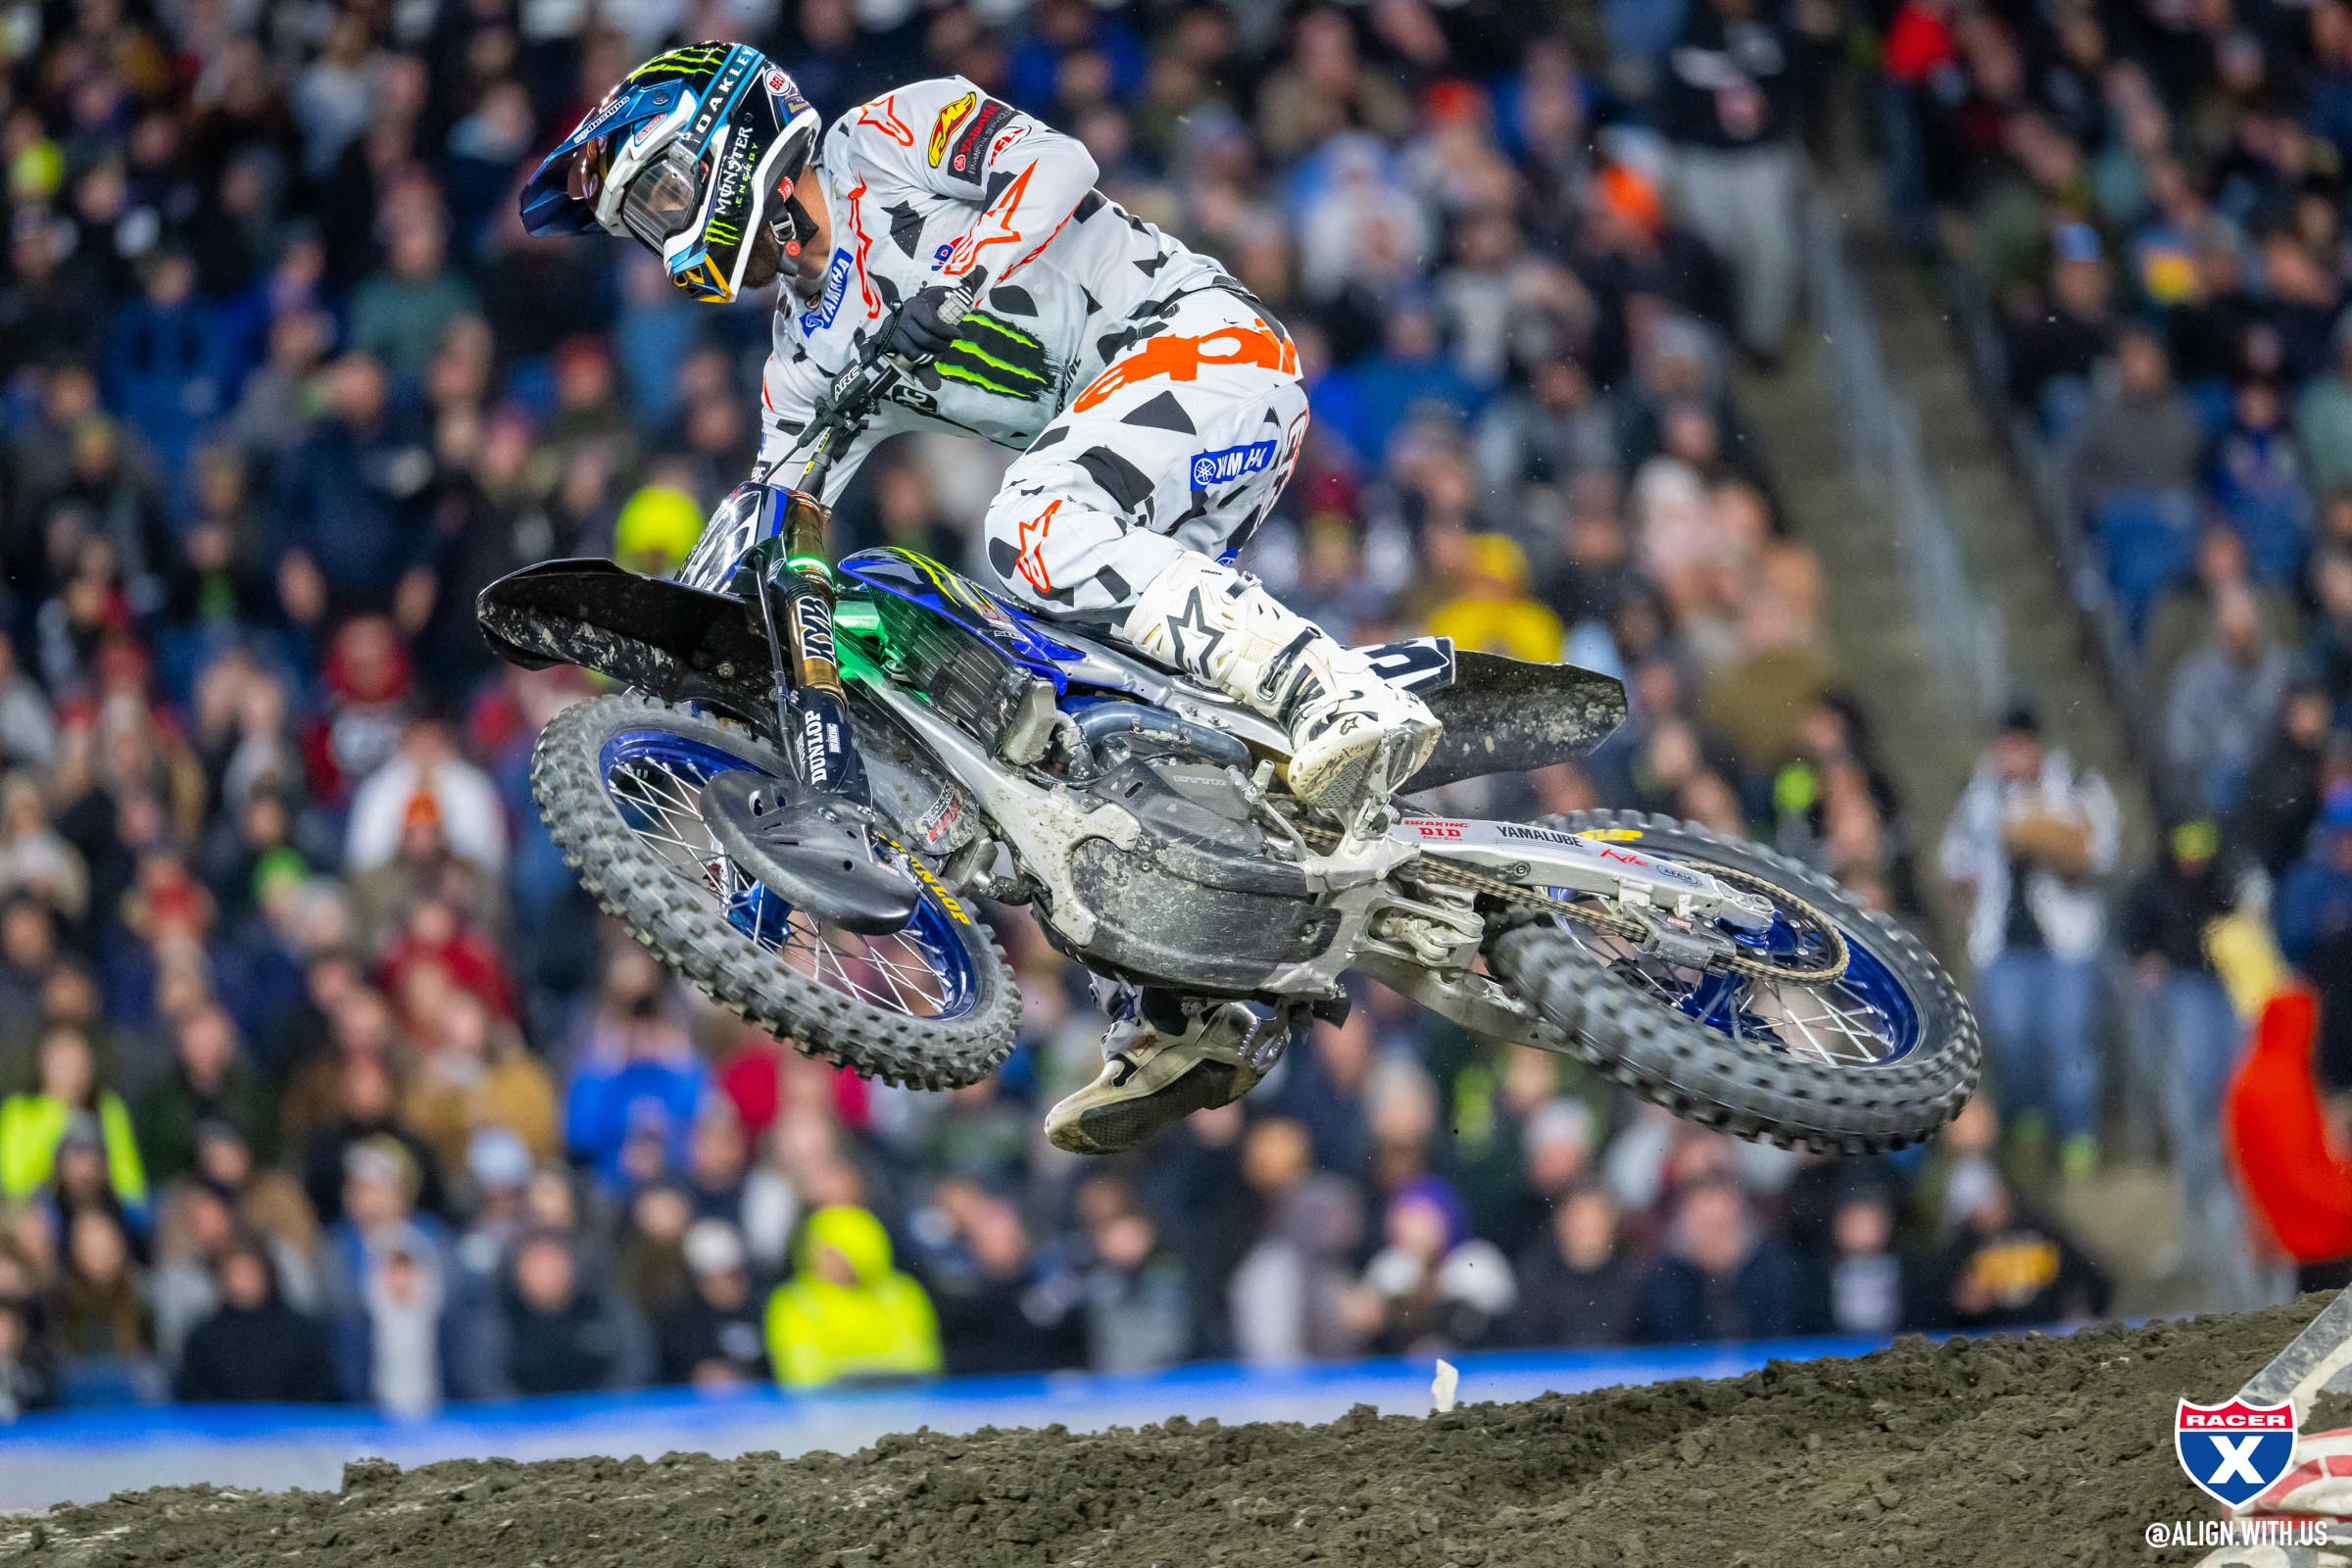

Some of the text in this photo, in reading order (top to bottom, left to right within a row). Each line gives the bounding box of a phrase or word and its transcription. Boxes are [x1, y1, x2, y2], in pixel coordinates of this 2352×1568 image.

[695, 48, 754, 134] OAKLEY
[714, 126, 754, 215] MONSTER
[735, 142, 759, 205] ENERGY
[968, 136, 989, 174] FINANCIAL
[820, 256, 852, 323] YAMAHA
[834, 365, 859, 402] ARC
[805, 710, 827, 785] DUNLOP
[1419, 827, 1461, 837] DID
[1495, 825, 1584, 848] YAMALUBE
